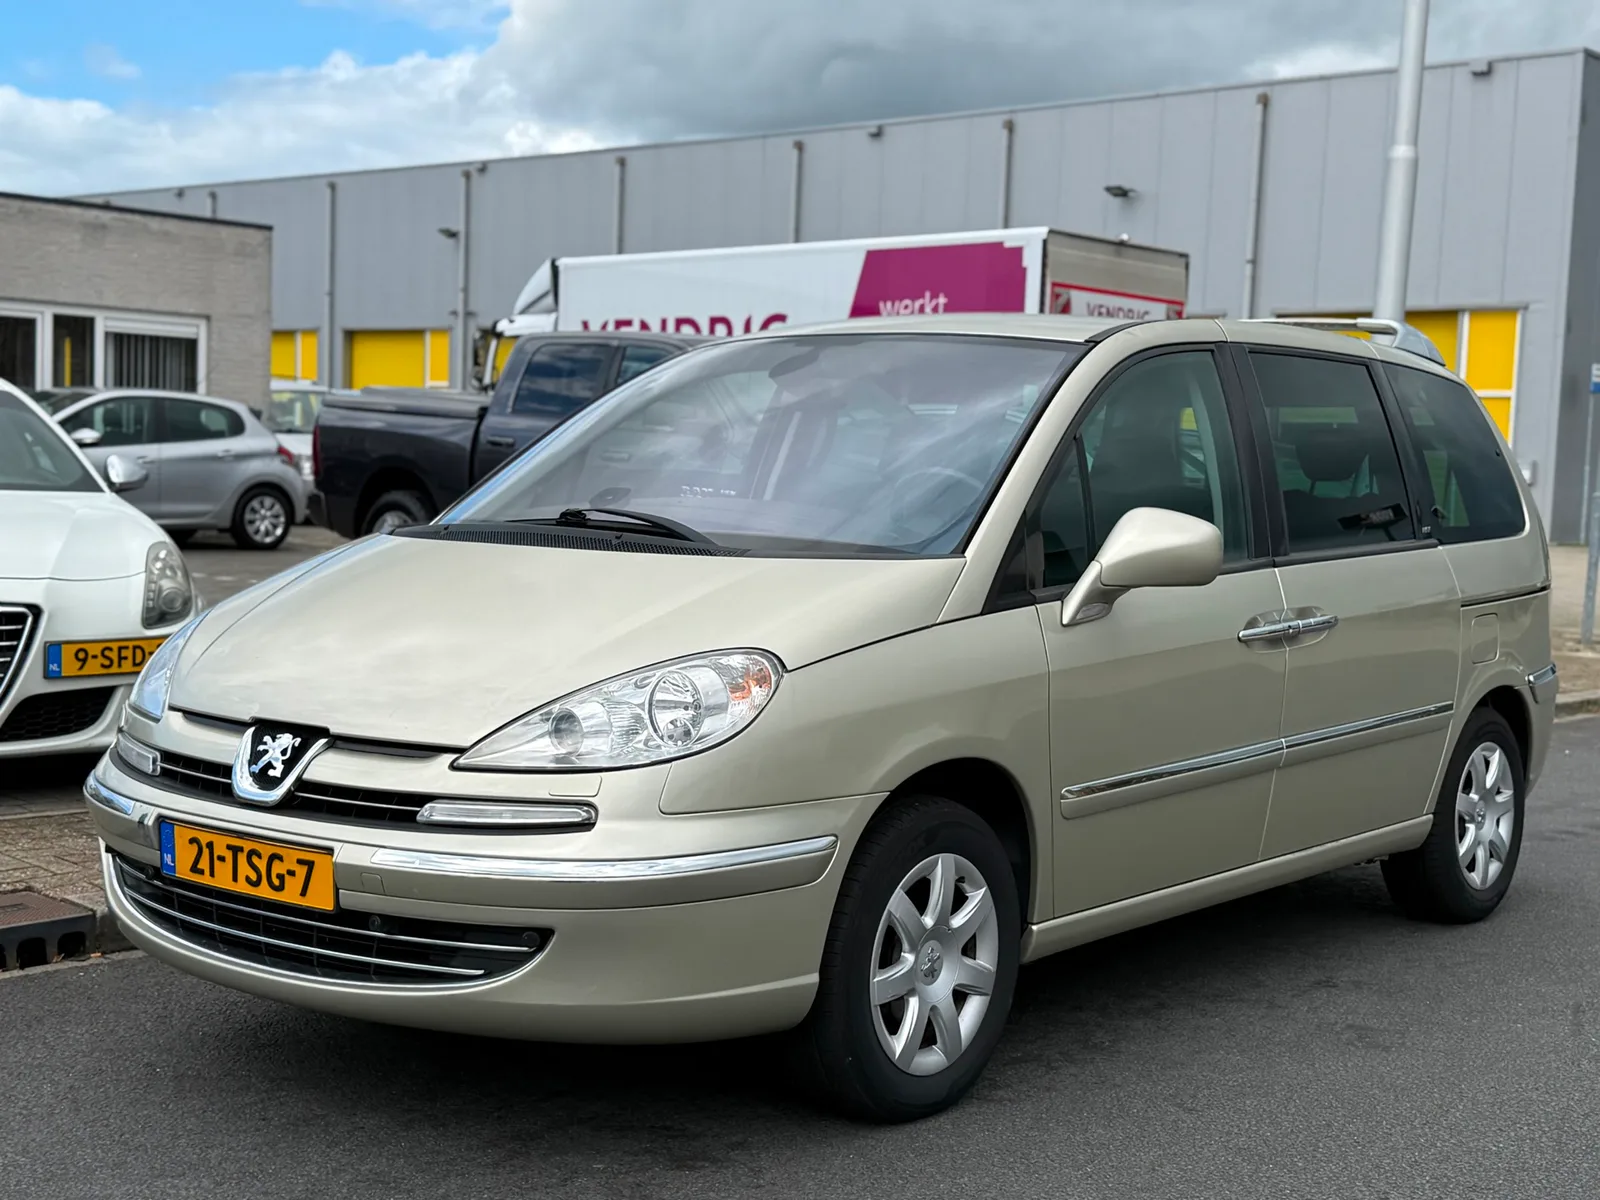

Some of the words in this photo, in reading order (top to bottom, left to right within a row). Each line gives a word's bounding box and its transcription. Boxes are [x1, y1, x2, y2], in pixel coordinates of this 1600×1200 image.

[74, 643, 162, 672] 9-SFD-
[163, 853, 175, 867] NL
[188, 836, 315, 898] 21-TSG-7
